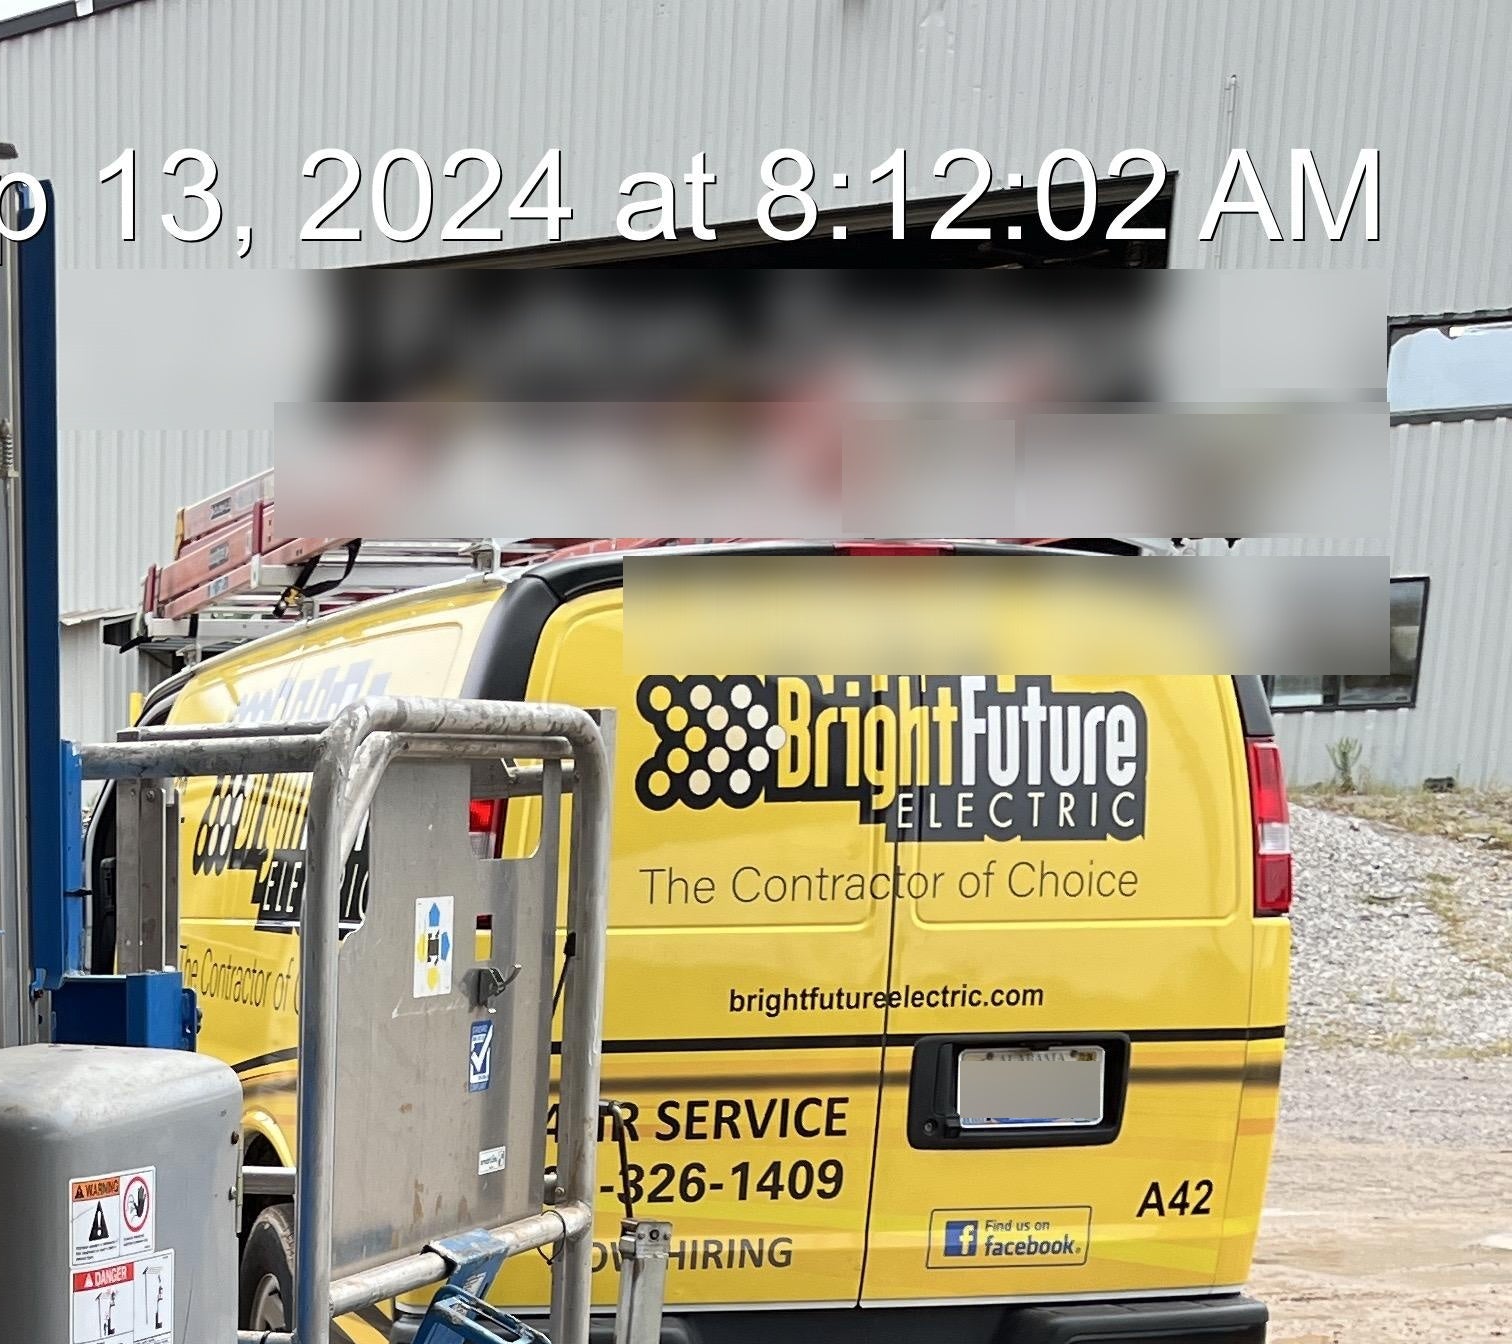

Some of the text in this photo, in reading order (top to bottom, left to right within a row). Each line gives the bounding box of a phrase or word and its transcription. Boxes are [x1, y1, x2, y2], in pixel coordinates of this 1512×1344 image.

[896, 791, 1137, 829] ELECTRIC
[639, 859, 1139, 906] The Contractor of Choice
[200, 948, 273, 1008] Contractor
[273, 957, 295, 1012] of
[728, 983, 1045, 1019] brightfutureelectric.com
[654, 1096, 850, 1141] SERVICE
[85, 1179, 120, 1197] WARNING
[1136, 1179, 1216, 1219] A42
[985, 1219, 1013, 1232] Find
[1016, 1221, 1031, 1232] us
[1034, 1219, 1051, 1231] on
[94, 1264, 128, 1287] DANGER
